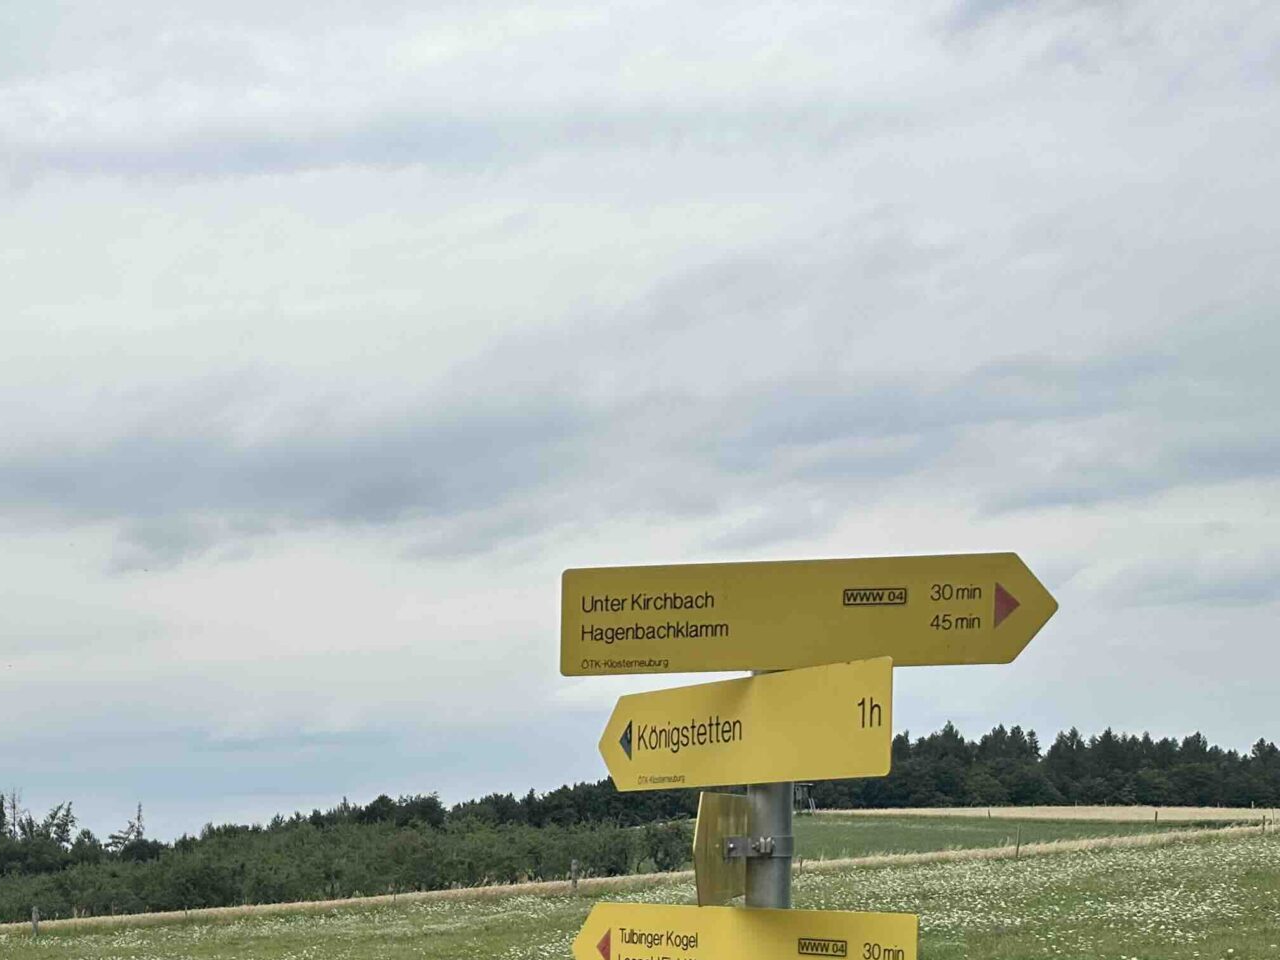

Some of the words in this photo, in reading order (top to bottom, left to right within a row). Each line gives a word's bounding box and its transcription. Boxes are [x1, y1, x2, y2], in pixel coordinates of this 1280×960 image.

[581, 594, 627, 613] Unter
[631, 590, 715, 611] Kirchbach
[845, 591, 885, 602] WWW
[887, 590, 904, 602] 04
[929, 583, 953, 601] 30
[955, 583, 982, 600] min
[929, 613, 952, 630] 45
[955, 613, 981, 629] min
[581, 620, 729, 644] Hagenbachklamm
[857, 696, 882, 728] 1h
[637, 715, 742, 754] Königstetten
[618, 927, 665, 949] Tulbinger
[666, 930, 699, 951] Kogel
[799, 940, 830, 953] WWW
[831, 942, 845, 954] 04
[862, 942, 881, 960] 30
